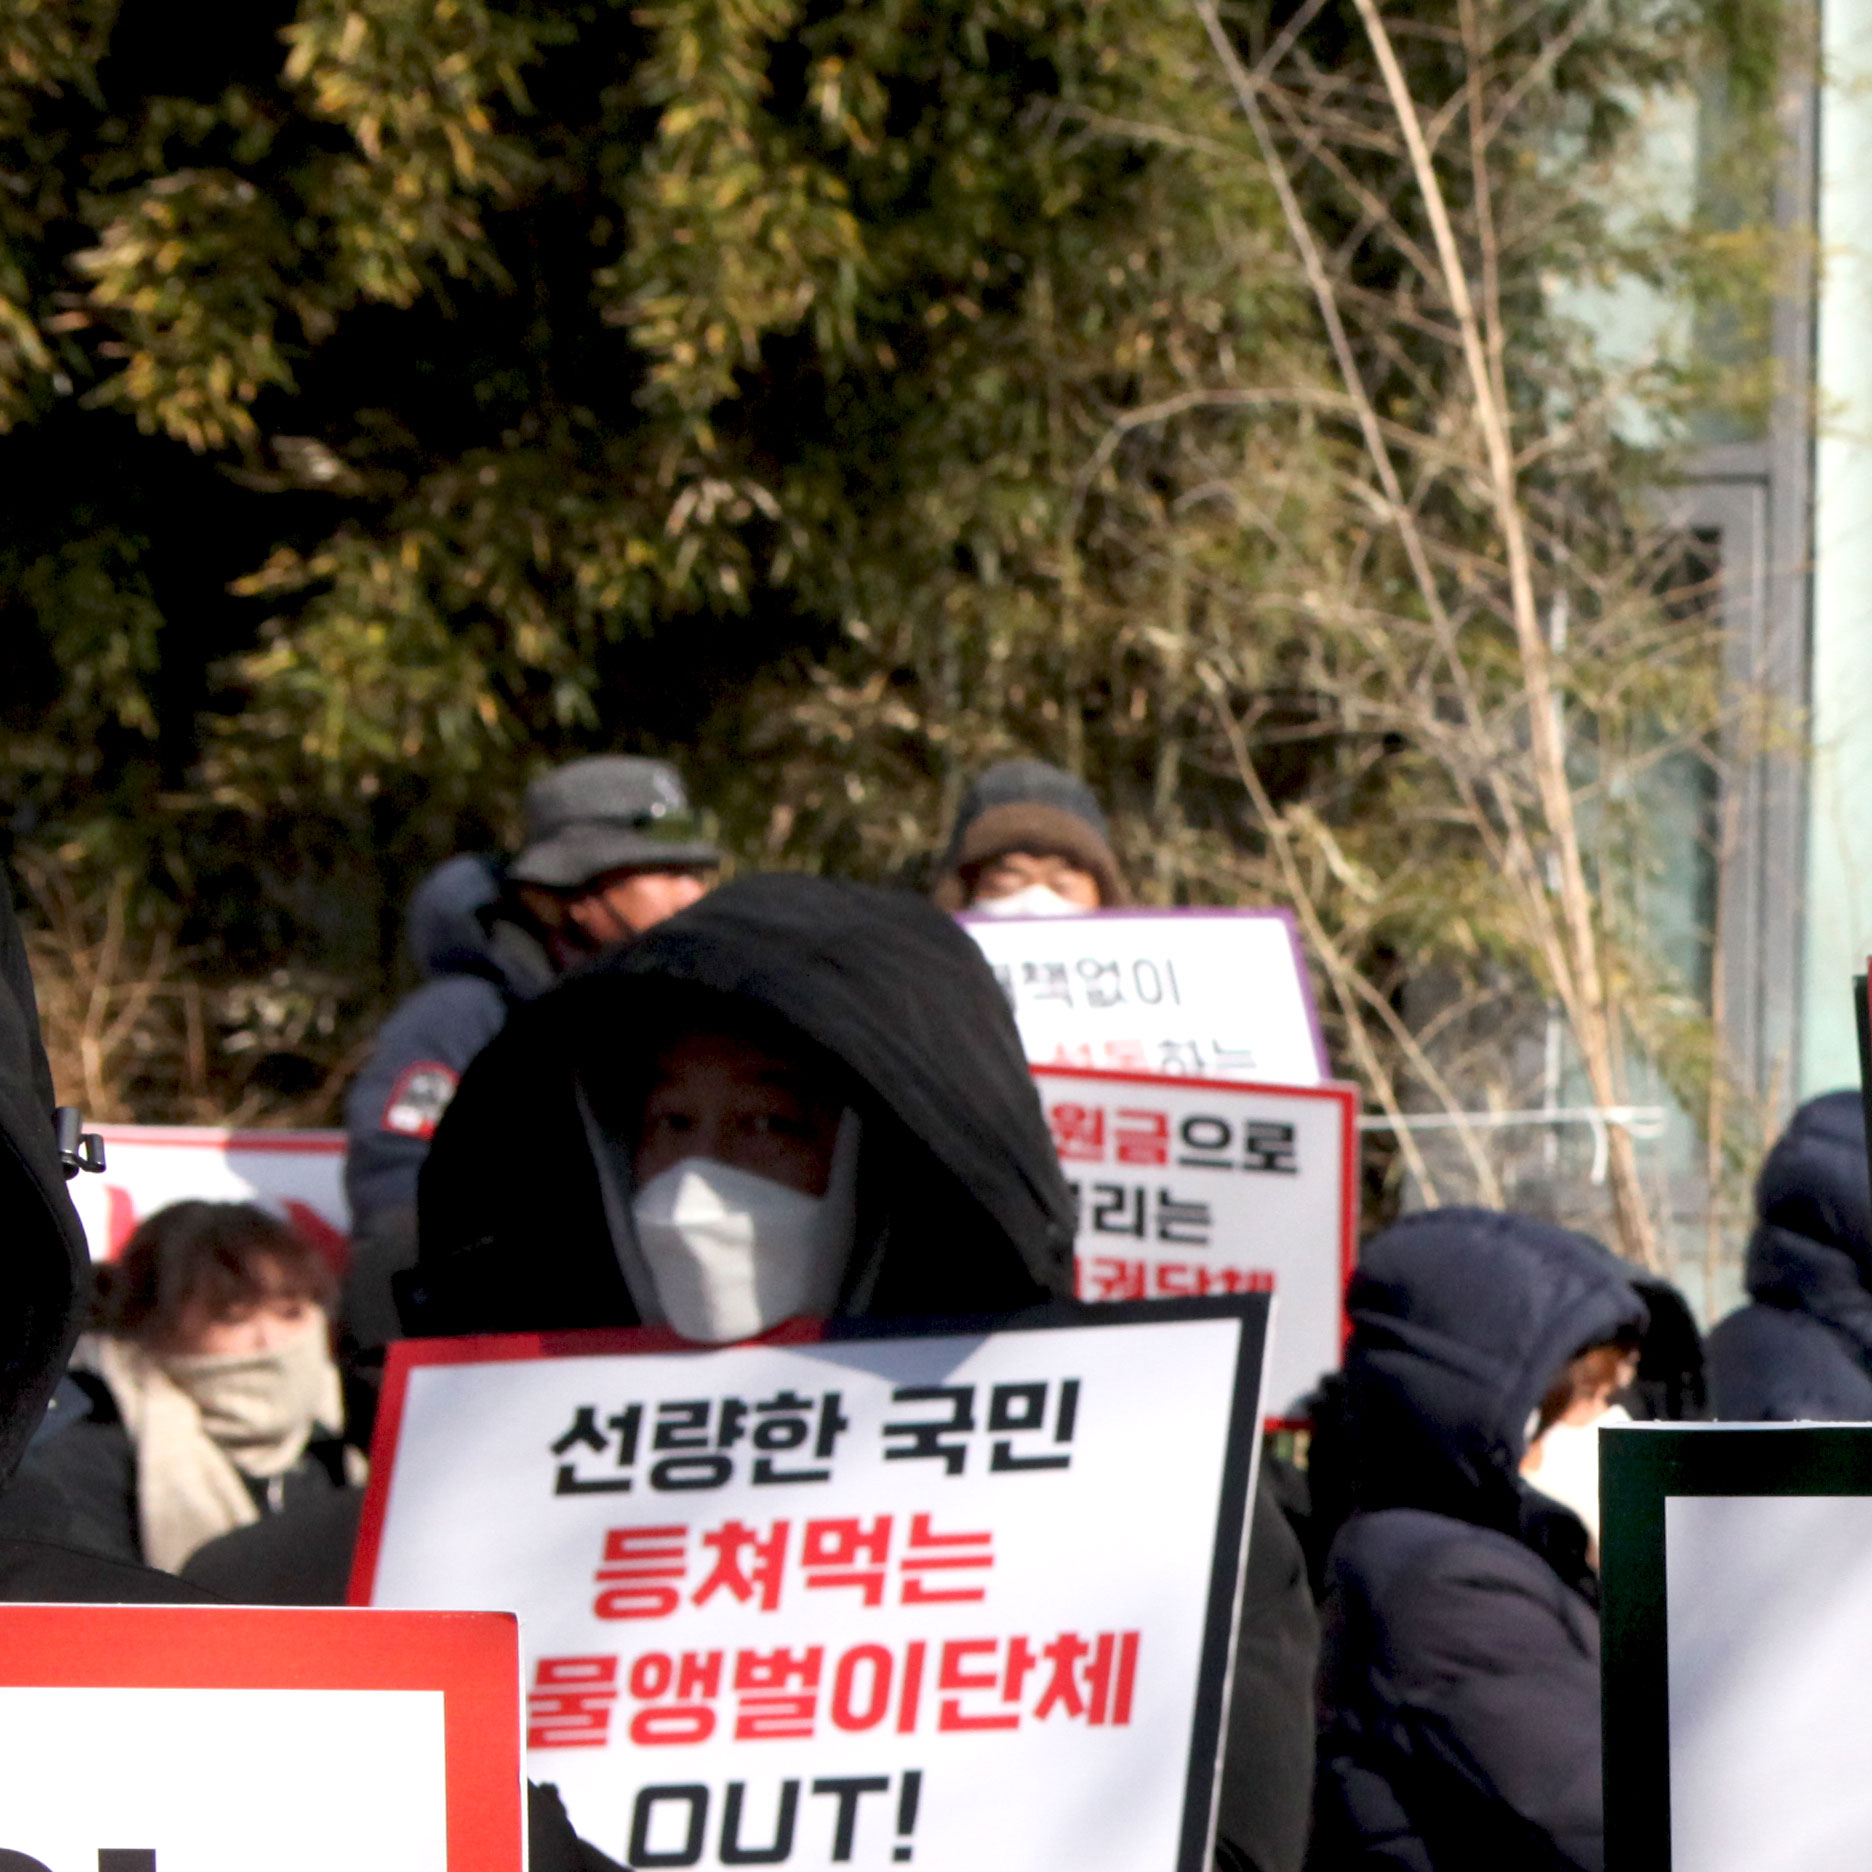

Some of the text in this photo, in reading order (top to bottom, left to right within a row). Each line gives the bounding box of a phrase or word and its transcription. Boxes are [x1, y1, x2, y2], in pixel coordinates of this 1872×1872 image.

[1068, 1183, 1211, 1245] 리는
[550, 1378, 1081, 1497] 선량한 국민
[592, 1512, 996, 1622] 등쳐먹는
[628, 1769, 923, 1870] OUT!
